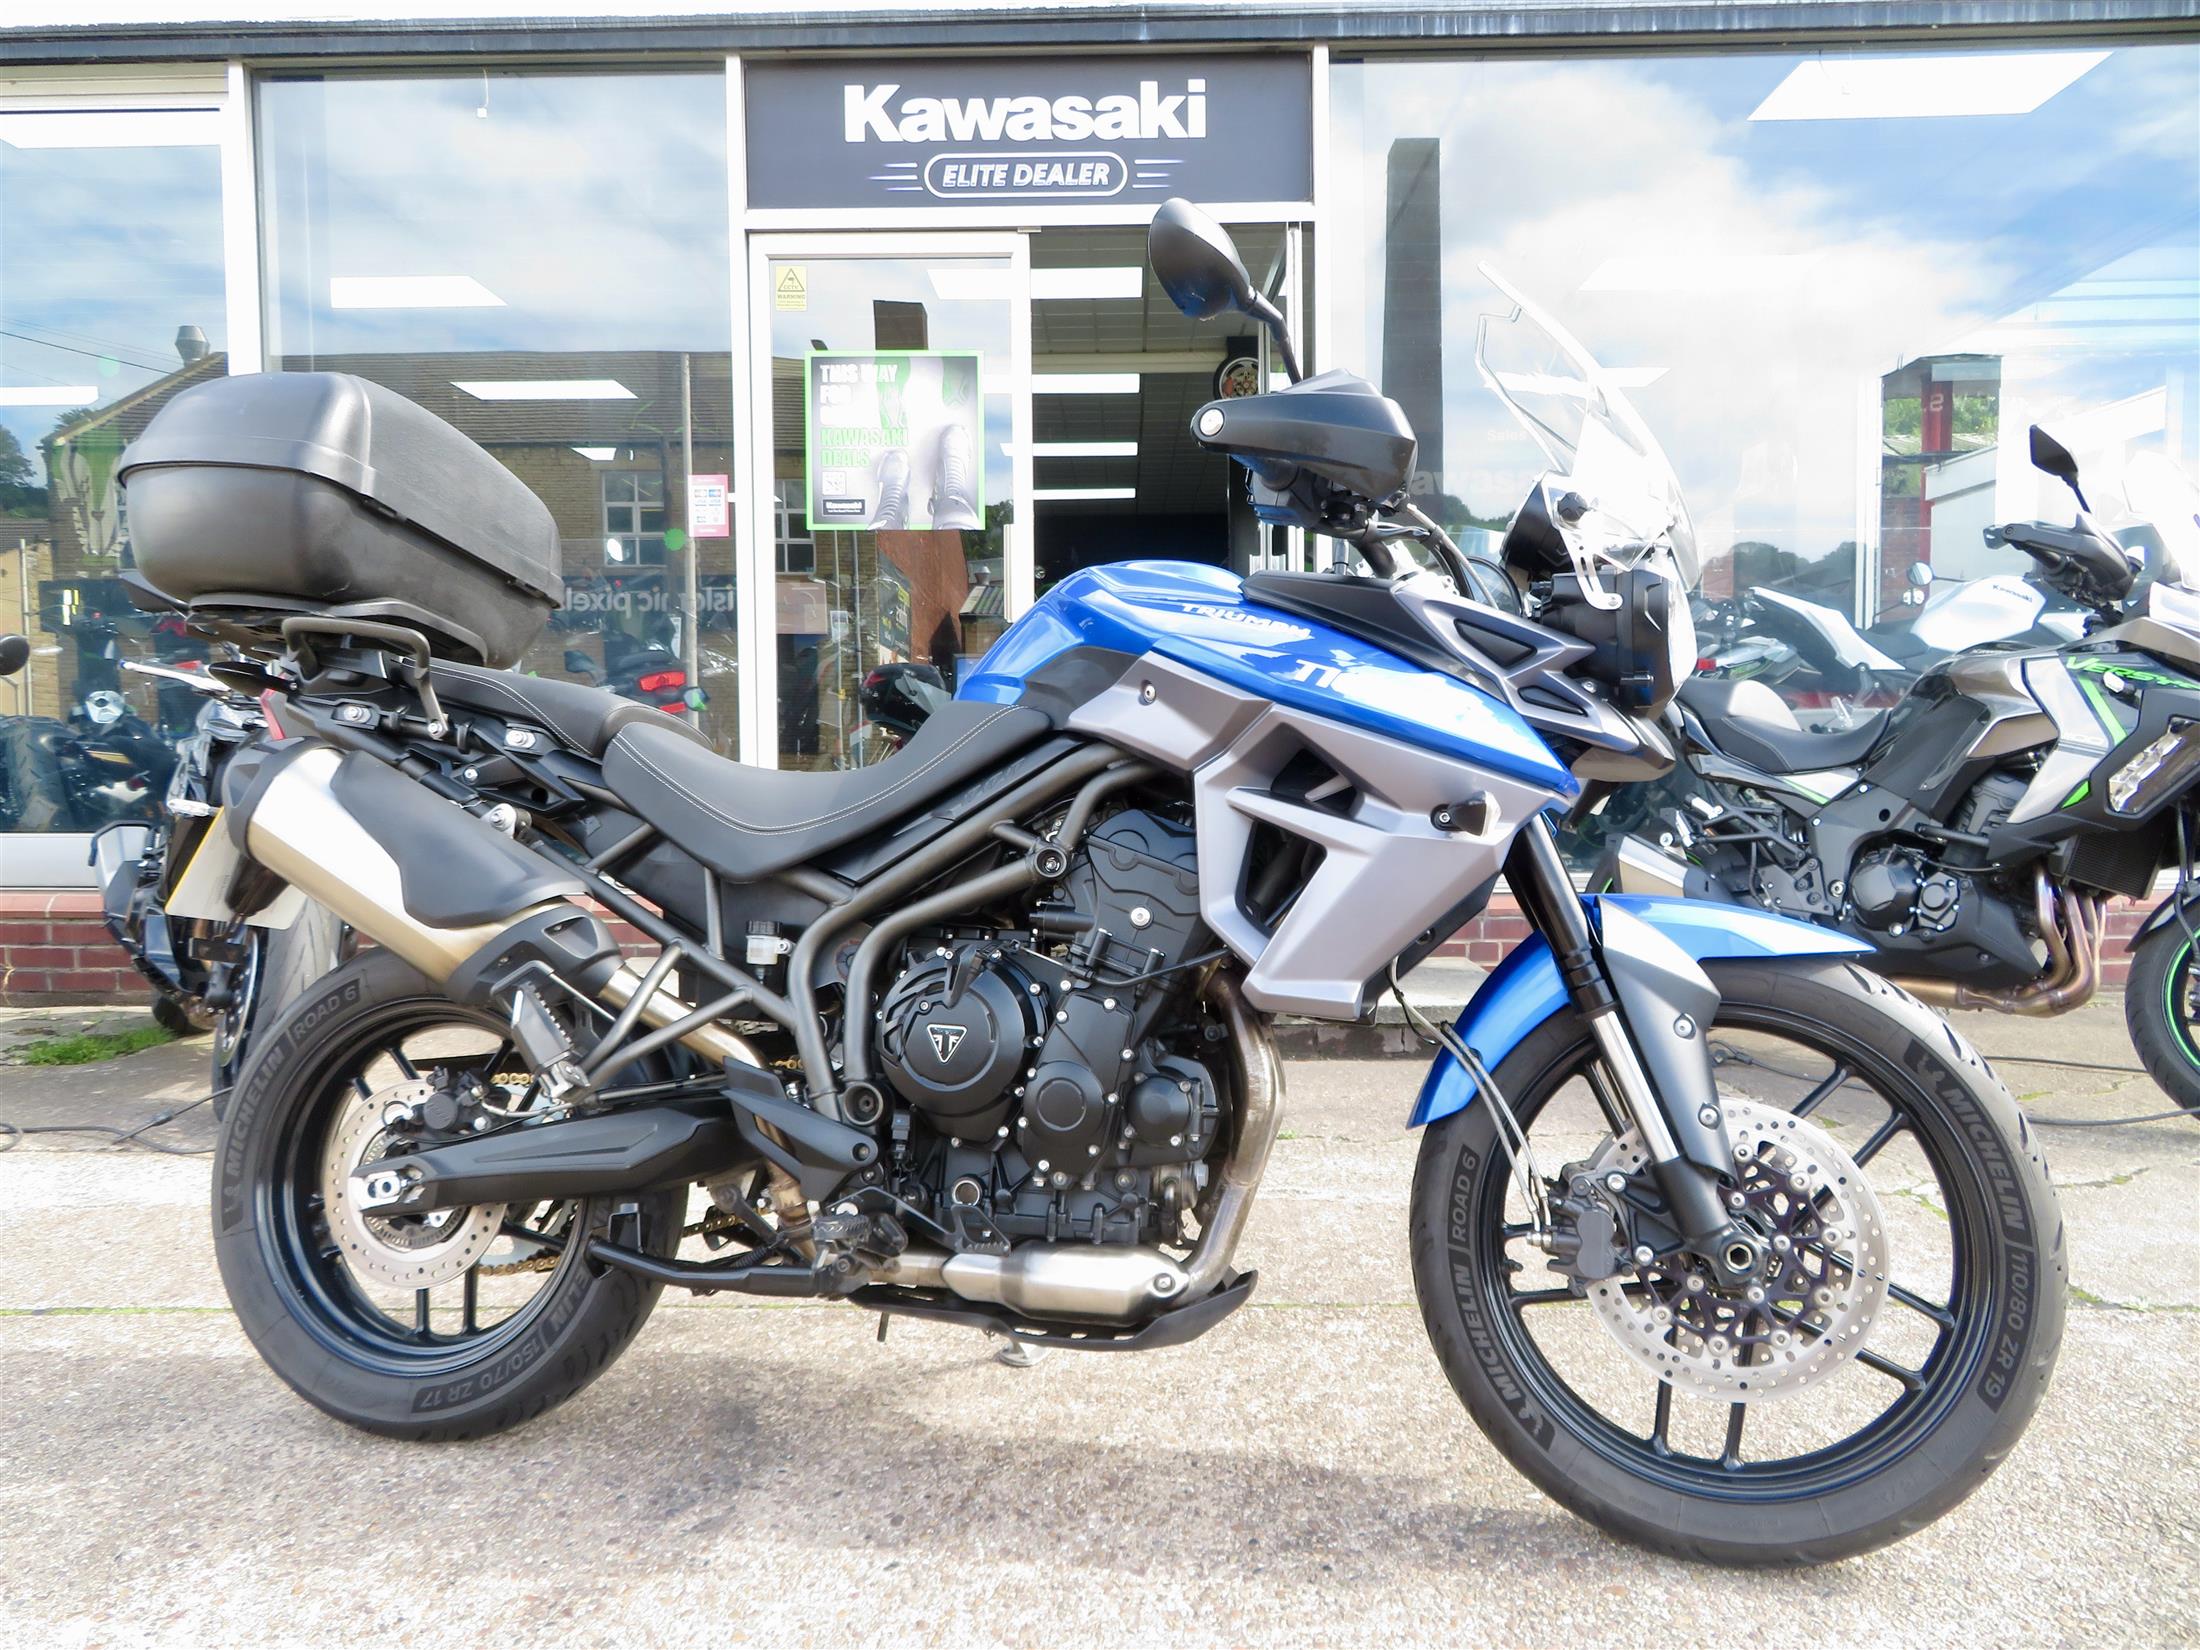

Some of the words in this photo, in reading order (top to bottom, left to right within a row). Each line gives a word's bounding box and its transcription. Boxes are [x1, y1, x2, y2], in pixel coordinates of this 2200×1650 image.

[844, 79, 1206, 143] Kawasaki
[942, 163, 1007, 187] ELITE
[1014, 162, 1110, 187] DEALER
[820, 364, 858, 383] THIS
[860, 364, 898, 383] WAY
[820, 427, 911, 448] KAWASAKI
[1181, 603, 1312, 639] TRIUMPH
[293, 996, 341, 1037] ROAD
[344, 985, 357, 1001] 6
[225, 1045, 286, 1177] MICHELIN
[1462, 1152, 1476, 1169] 6
[1942, 1087, 2025, 1233] MICHELIN
[1453, 1176, 1472, 1242] ROAD
[2008, 1250, 2029, 1330] 110/80
[1454, 1264, 1522, 1401] MICHELIN
[479, 1338, 542, 1389] 150/70
[1997, 1334, 2020, 1374] ZR
[419, 1389, 442, 1409] 17
[448, 1380, 473, 1399] ZR
[1984, 1376, 2006, 1400] 19
